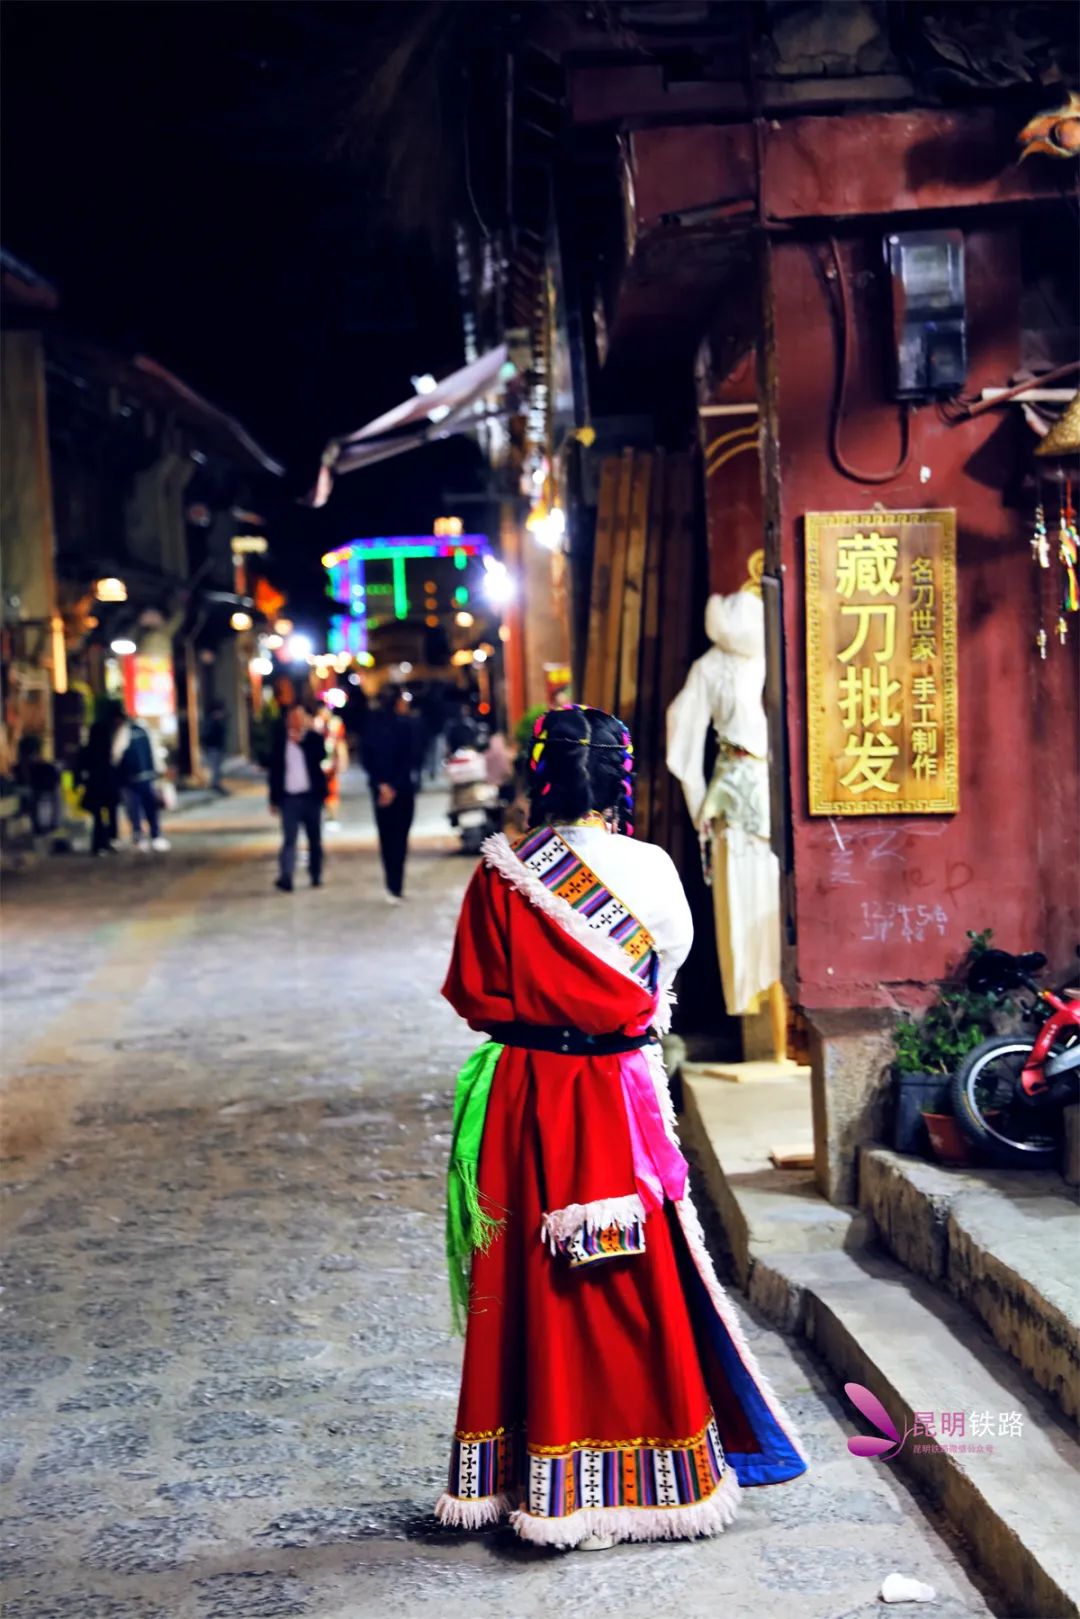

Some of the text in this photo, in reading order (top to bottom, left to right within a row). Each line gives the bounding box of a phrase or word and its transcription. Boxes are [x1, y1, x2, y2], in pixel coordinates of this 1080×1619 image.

[836, 531, 900, 794] 藏刀批发
[911, 557, 938, 781] 名刀世家 手工制作
